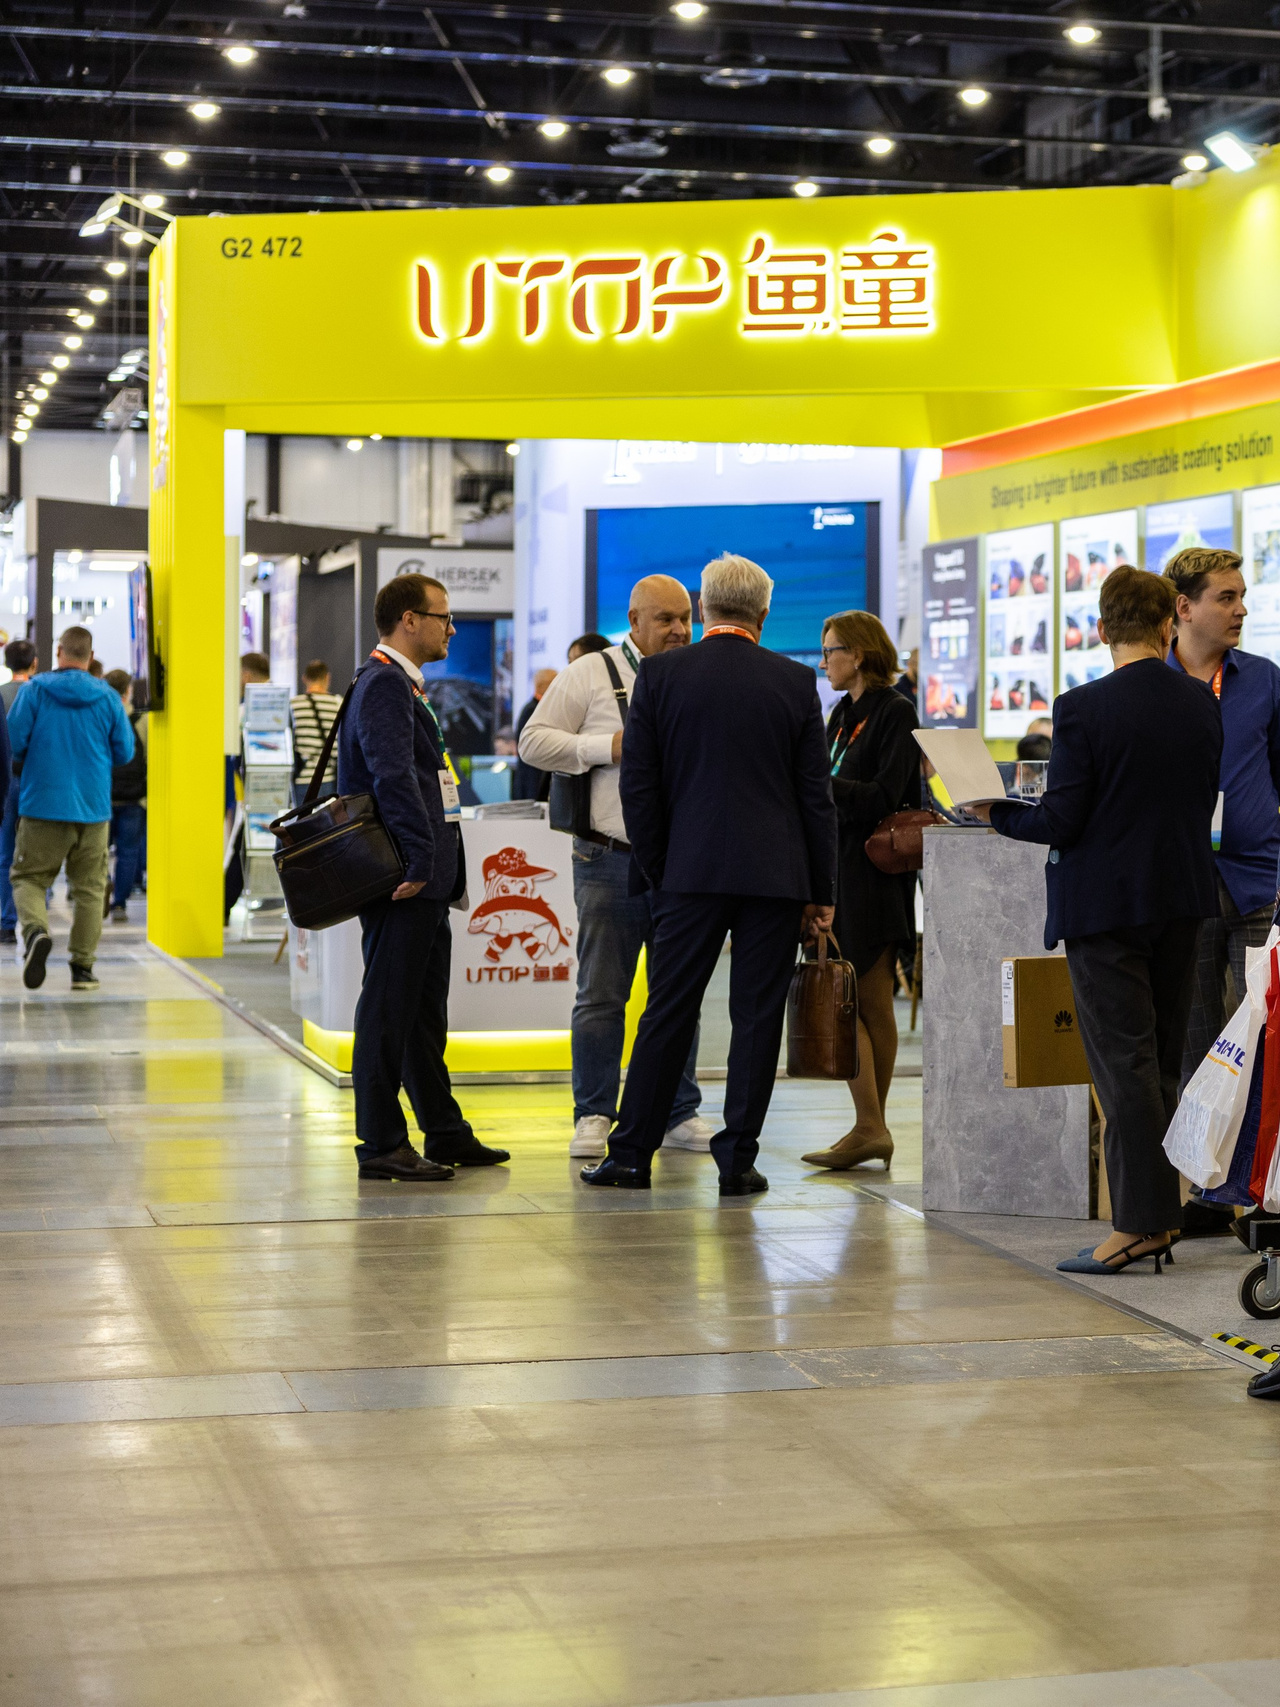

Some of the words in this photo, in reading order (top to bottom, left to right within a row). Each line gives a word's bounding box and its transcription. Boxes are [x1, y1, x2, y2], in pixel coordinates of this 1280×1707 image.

[221, 237, 252, 258] G2
[261, 236, 302, 257] 472
[415, 254, 727, 340] UTOP
[1226, 433, 1273, 463] solution
[466, 965, 530, 983] UTOP
